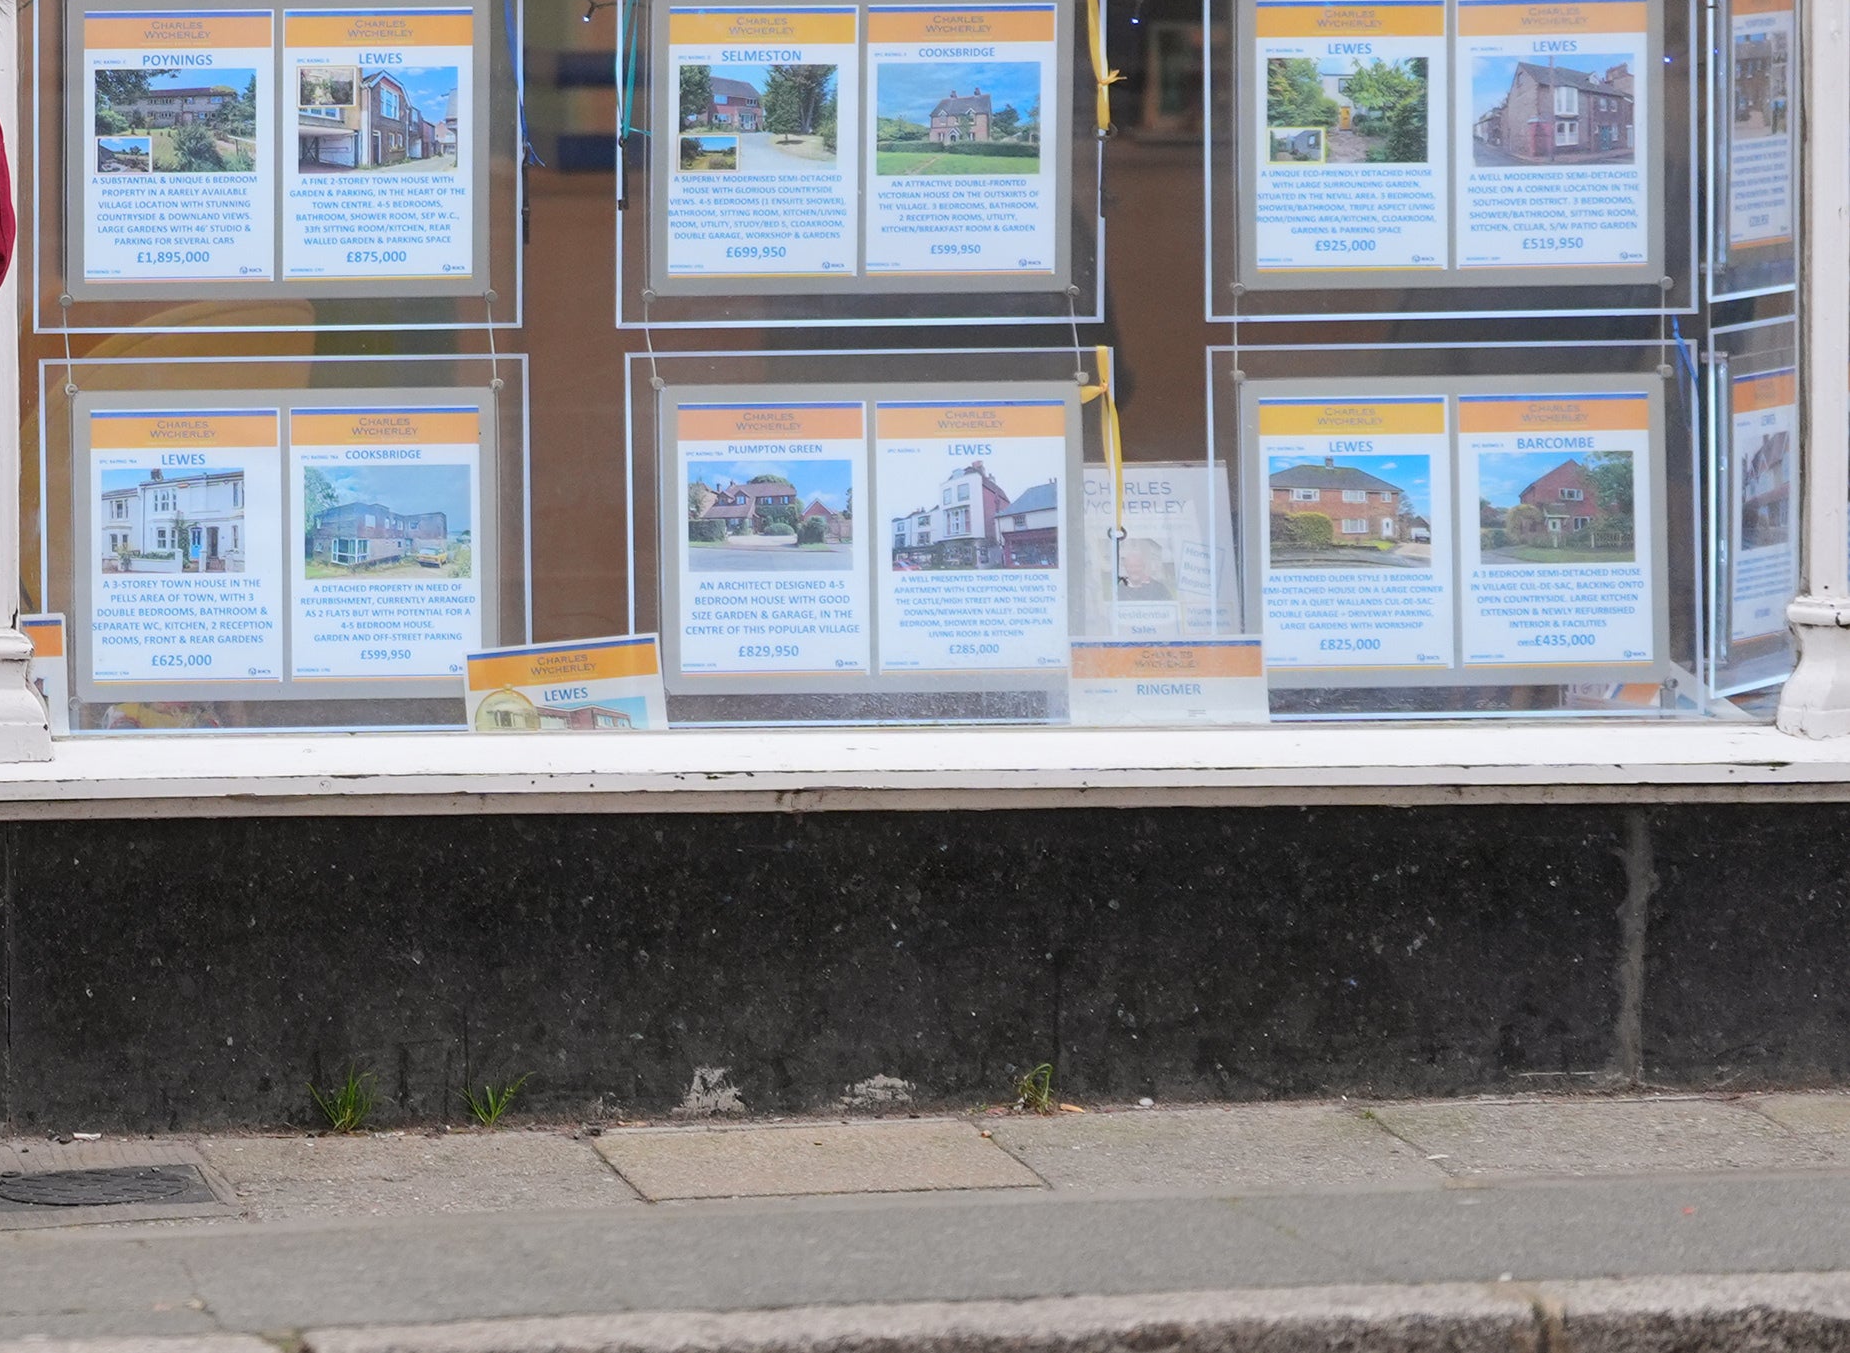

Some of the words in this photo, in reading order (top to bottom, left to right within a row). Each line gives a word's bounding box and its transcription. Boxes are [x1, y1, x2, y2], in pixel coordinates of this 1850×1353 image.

[151, 21, 206, 29] CHARLES
[143, 31, 211, 39] WYCHERLEY
[1328, 43, 1372, 54] LEWES
[1533, 41, 1577, 52] LEWES
[722, 51, 801, 61] SELMESTON
[919, 48, 994, 57] COOKSBRIDGE
[143, 55, 212, 65] POYNINGS
[359, 53, 402, 64] LEWES
[1315, 240, 1375, 251] £925,000
[1523, 238, 1583, 249] £519,950
[726, 247, 786, 257] £699,950
[931, 245, 981, 254] £599,950
[138, 252, 210, 263] £1,895,000
[347, 251, 406, 262] £875,000
[1330, 441, 1373, 452] LEWES
[1517, 437, 1594, 449] BARCOMBE
[346, 450, 421, 459] COOKSBRIDGE
[728, 445, 786, 453] PLUMPTON
[789, 445, 822, 453] GREEN
[949, 444, 991, 455] LEWES
[162, 454, 205, 465] LEWES
[949, 644, 999, 654] £285,000
[1320, 639, 1380, 650] £825,000
[361, 650, 411, 659] £599,950
[739, 646, 799, 657] £829,950
[152, 655, 212, 666] £625,000
[537, 654, 588, 665] CHARLES
[531, 664, 596, 676] WYCHERLEY
[544, 687, 588, 702] LEWES
[1137, 684, 1201, 695] RINGMER
